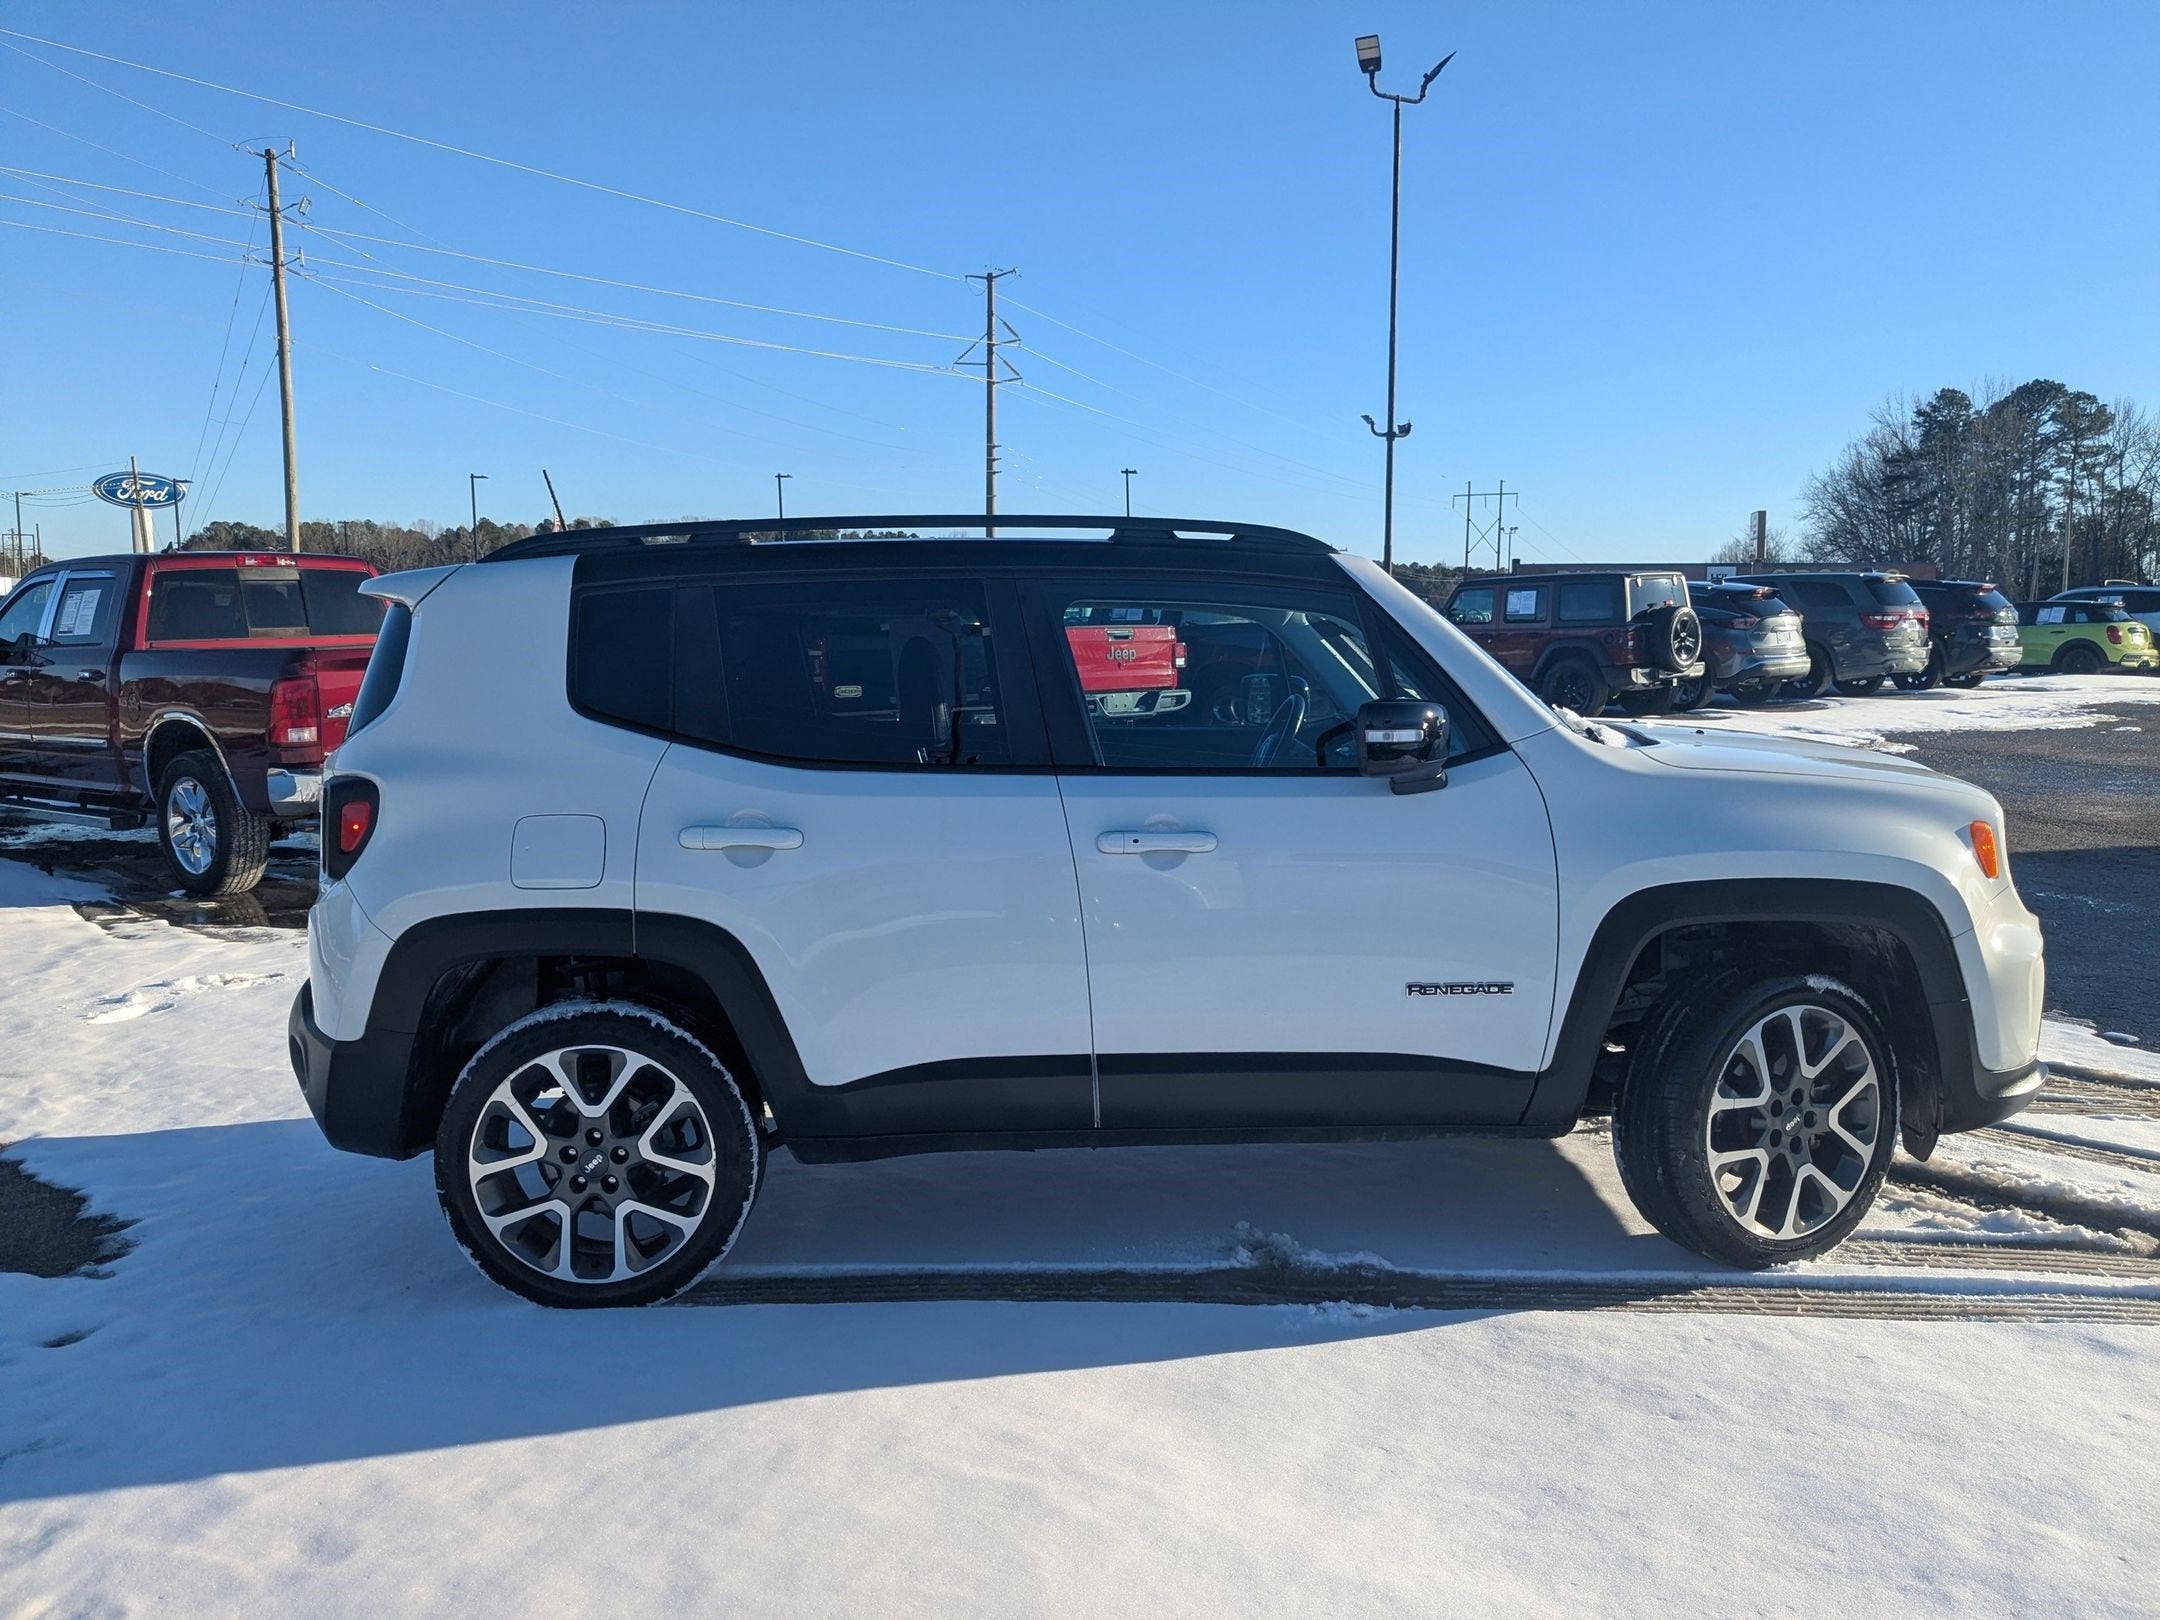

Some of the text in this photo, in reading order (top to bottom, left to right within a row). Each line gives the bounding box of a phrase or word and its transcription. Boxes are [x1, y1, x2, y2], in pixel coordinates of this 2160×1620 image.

[1107, 647, 1137, 662] Jeep
[1405, 982, 1514, 997] RENEGADE
[584, 1154, 603, 1174] Jeep
